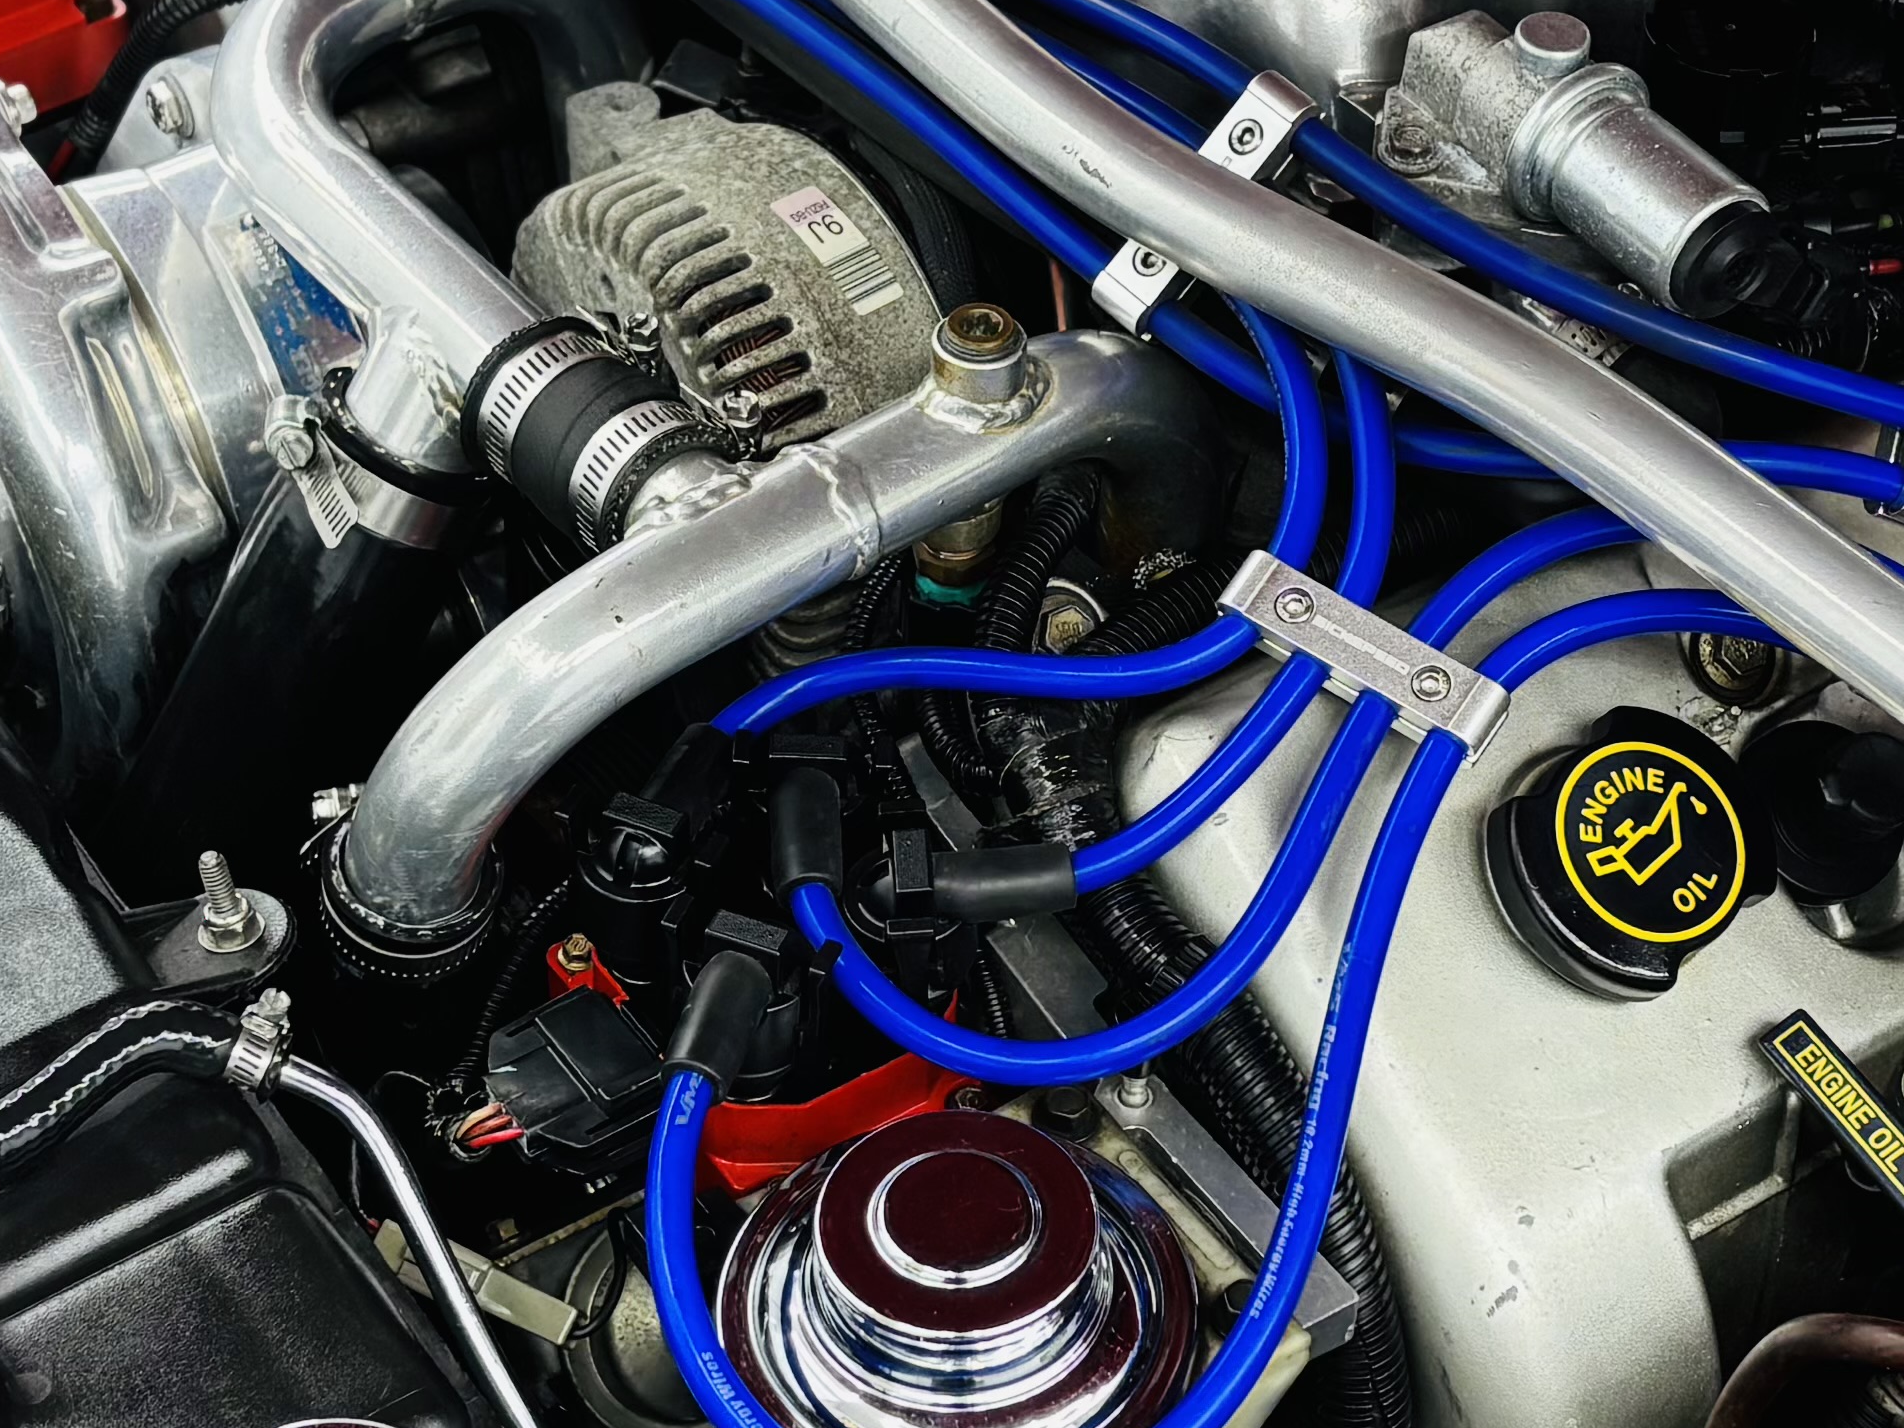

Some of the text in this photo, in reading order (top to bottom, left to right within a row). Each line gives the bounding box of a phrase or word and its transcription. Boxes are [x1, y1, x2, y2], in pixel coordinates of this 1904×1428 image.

[1579, 766, 1664, 843] ENGINE
[1672, 873, 1717, 912] OIL
[1307, 1023, 1336, 1111] Racing
[1794, 1043, 1876, 1130] ENGINE
